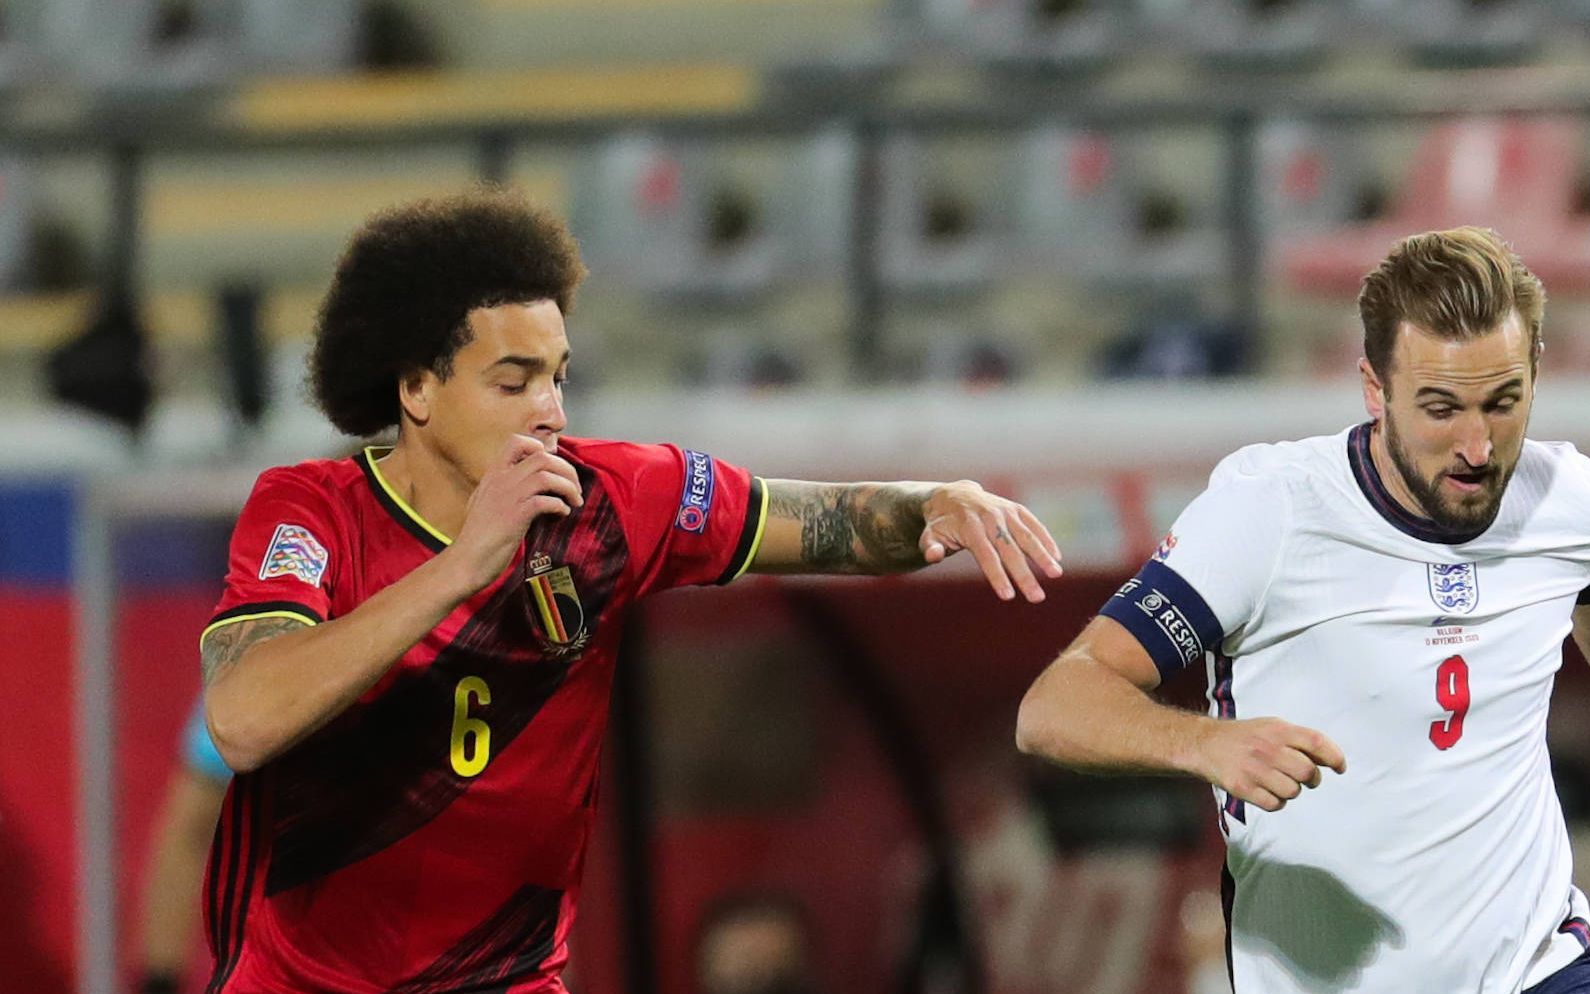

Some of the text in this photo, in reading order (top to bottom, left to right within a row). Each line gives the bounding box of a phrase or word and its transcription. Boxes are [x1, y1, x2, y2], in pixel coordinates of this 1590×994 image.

[690, 450, 707, 506] RESPECT
[450, 676, 492, 778] 6
[1430, 655, 1471, 752] 9
